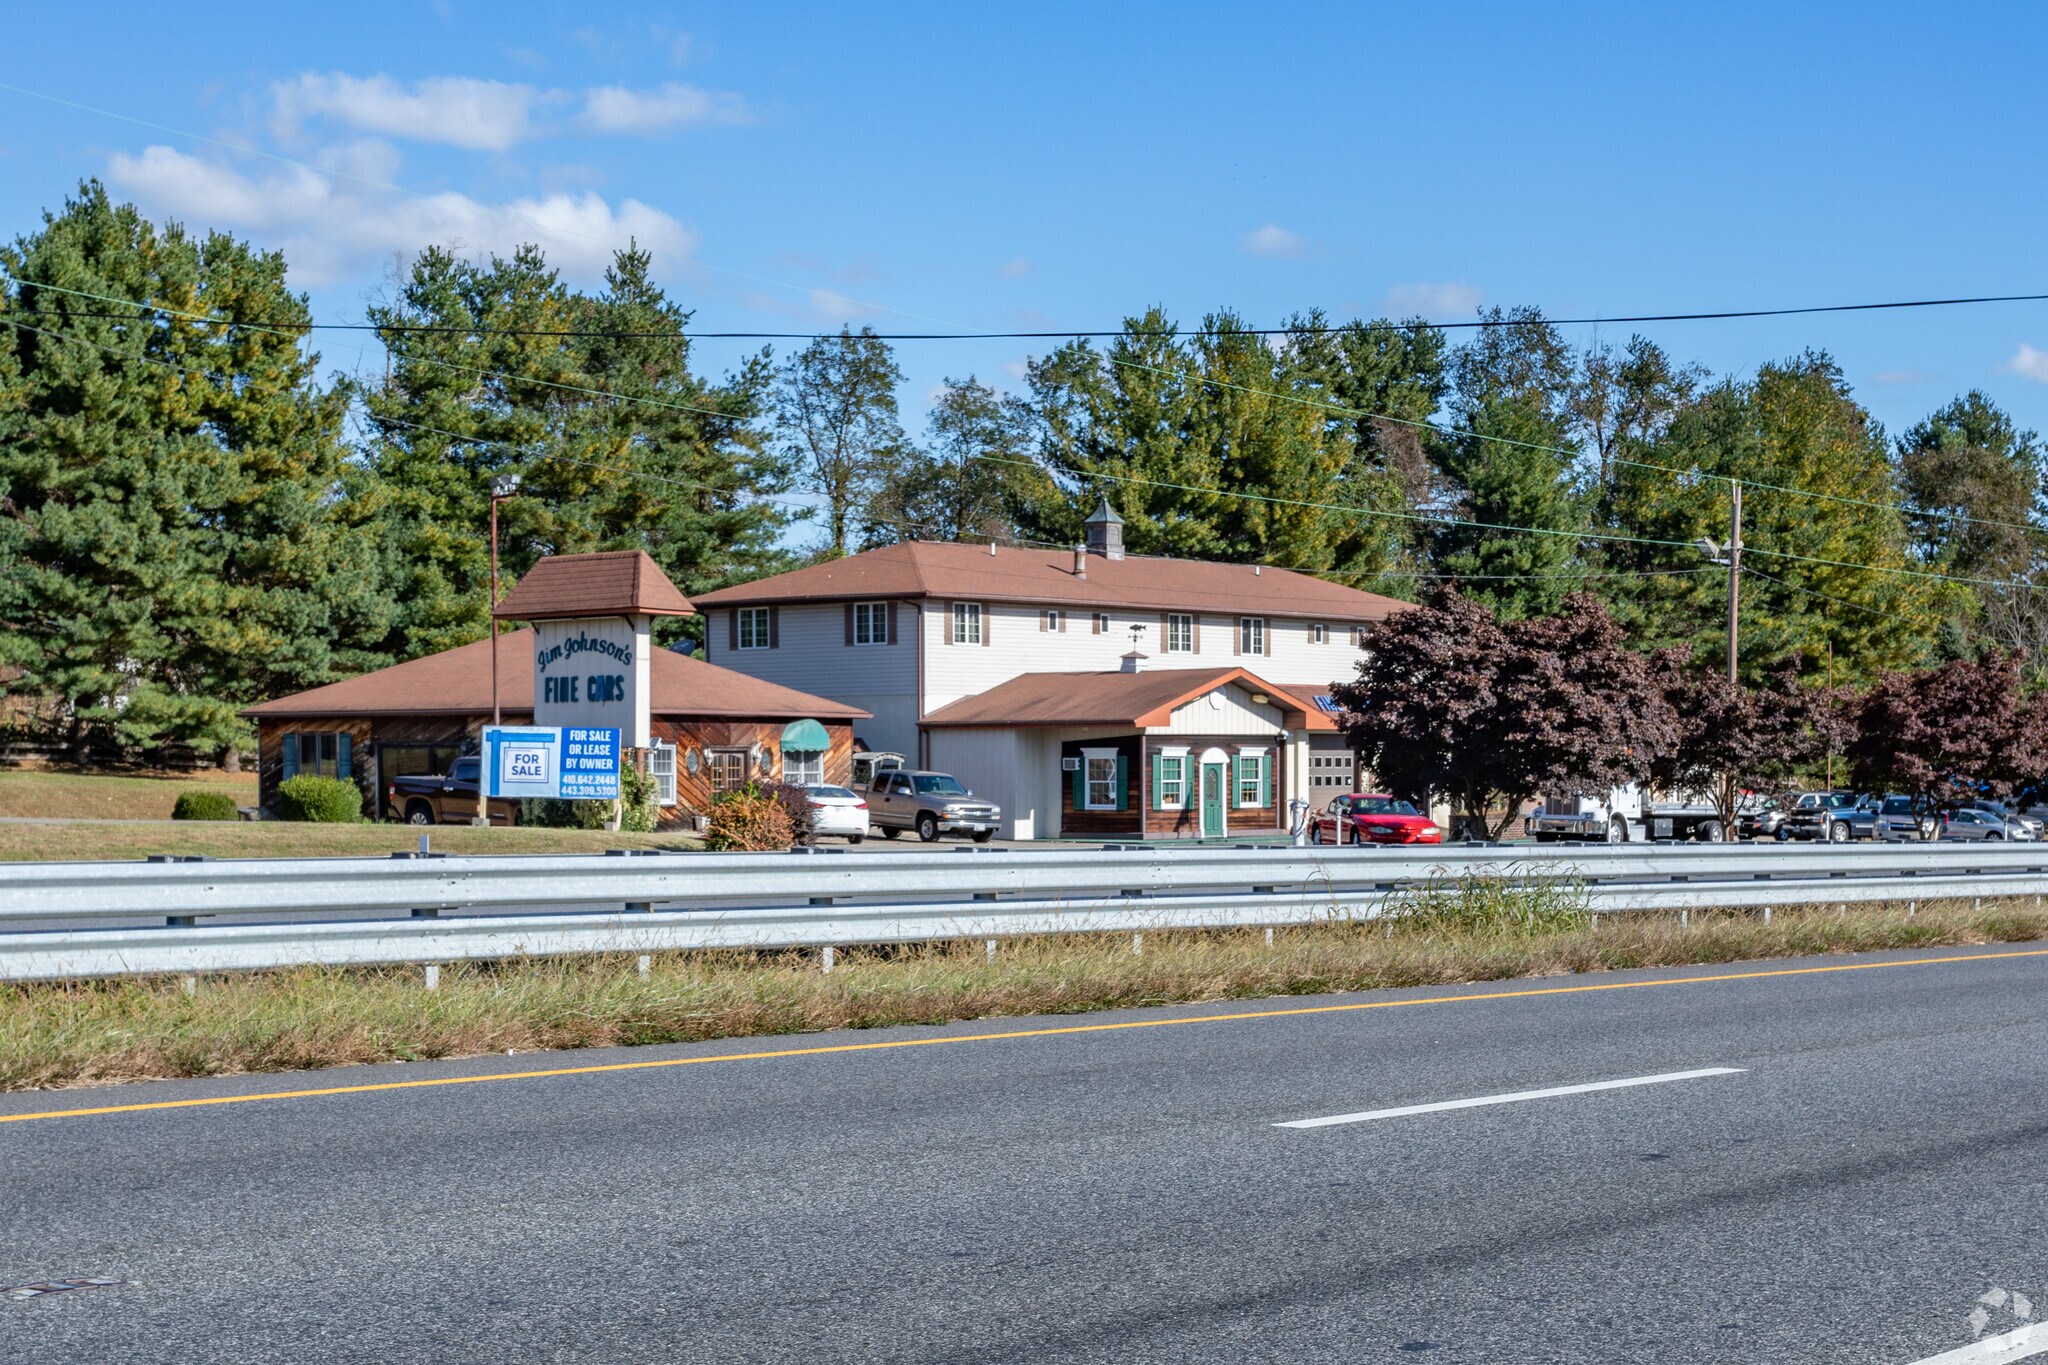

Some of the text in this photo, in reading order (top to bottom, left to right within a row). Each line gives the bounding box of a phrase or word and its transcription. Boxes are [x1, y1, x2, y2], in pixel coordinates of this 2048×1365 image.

[538, 630, 632, 673] Jim Johnson's
[587, 674, 624, 703] CARS
[570, 730, 611, 741] FOR SALE
[569, 744, 611, 755] OR LEASE
[514, 753, 539, 764] FOR
[566, 758, 613, 770] BY OWNER
[511, 765, 542, 776] SALE
[562, 774, 616, 785] 410.642.2448
